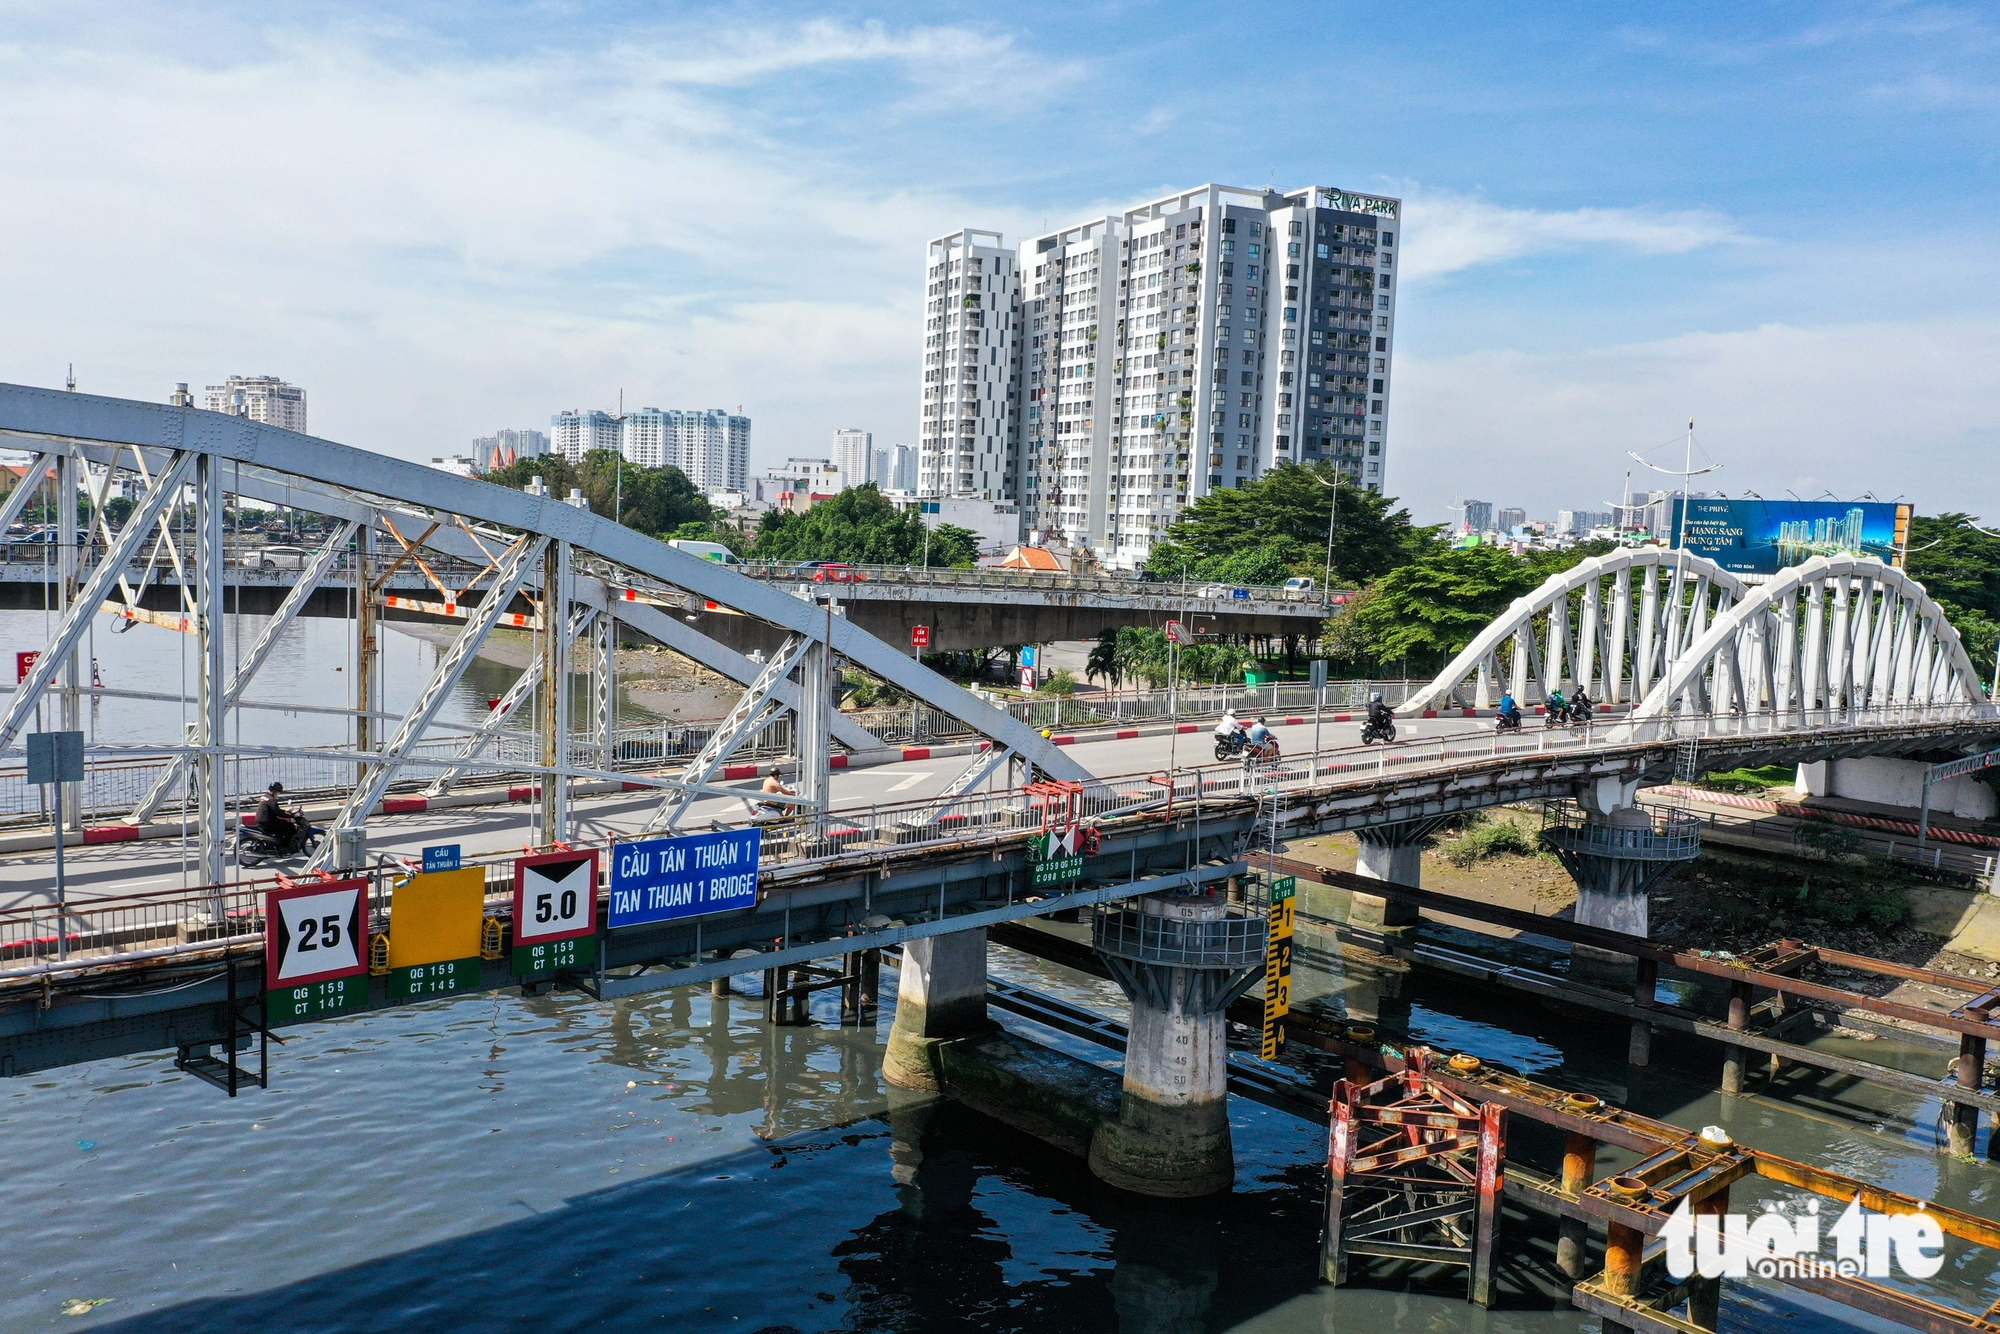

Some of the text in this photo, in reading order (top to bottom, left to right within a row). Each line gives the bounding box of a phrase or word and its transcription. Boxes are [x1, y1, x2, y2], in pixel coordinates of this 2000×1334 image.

[1324, 187, 1396, 214] RIVA PARK
[1692, 527, 1717, 535] HẠNG
[1683, 537, 1712, 545] TRUNG
[621, 840, 751, 878] CẦU TÂN THUẬN 1
[1036, 858, 1082, 872] QG 159 QG 159
[1043, 872, 1056, 881] 098
[1068, 868, 1080, 877] 096
[614, 873, 754, 914] TAN THUAN 1 BRIDGE
[536, 890, 576, 923] 5.0
[1285, 907, 1290, 927] 1
[298, 915, 340, 952] 25
[532, 941, 574, 957] QG 159
[1282, 946, 1290, 968] 2
[410, 963, 454, 979] QG 159
[534, 954, 574, 970] CT 143
[294, 981, 344, 999] QG 159
[410, 979, 455, 993] CT 145
[295, 996, 344, 1015] CT 147
[1280, 986, 1287, 1006] 3
[1278, 1024, 1285, 1044] 4
